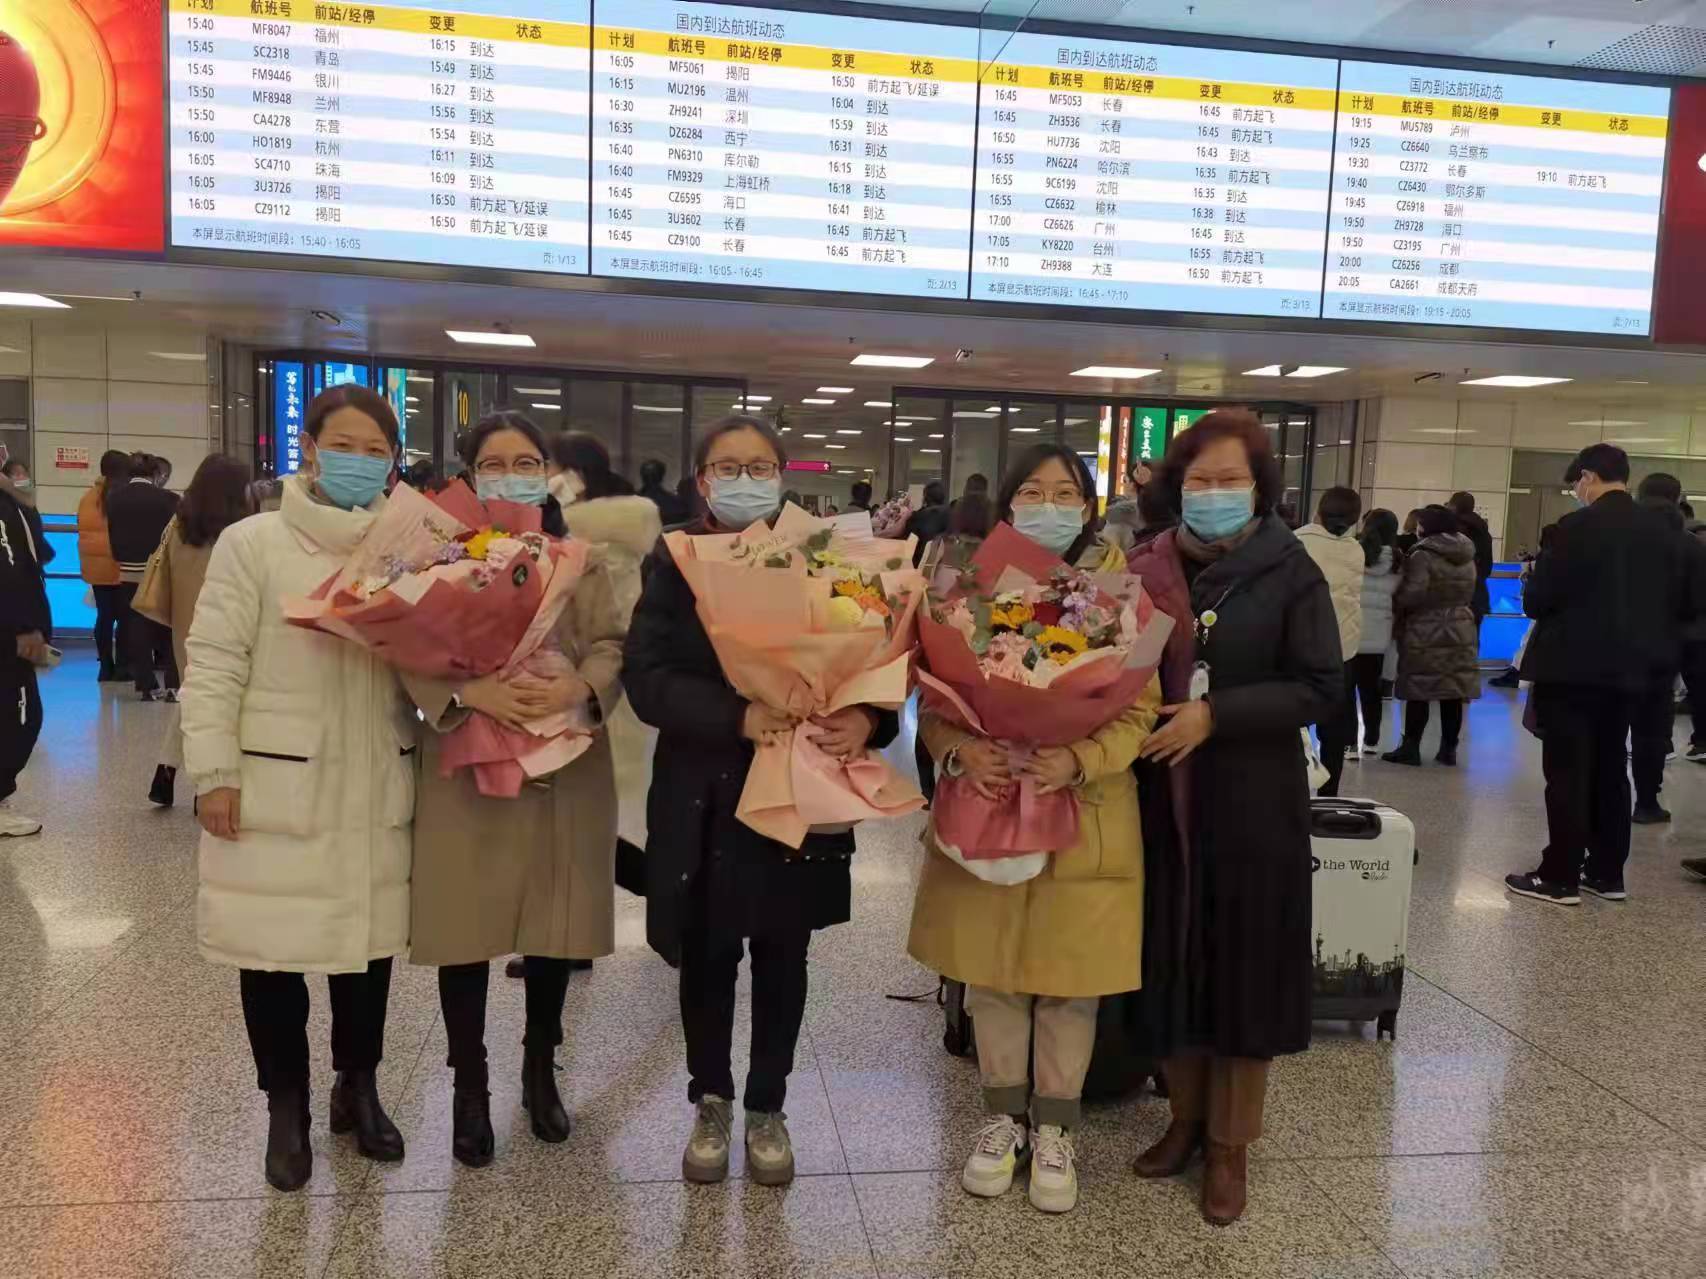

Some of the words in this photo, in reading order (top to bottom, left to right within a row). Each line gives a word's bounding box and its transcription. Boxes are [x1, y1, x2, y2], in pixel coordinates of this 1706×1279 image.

[249, 0, 292, 17] 航班号
[315, 4, 375, 24] 前站/经停
[428, 16, 456, 32] 变更
[516, 23, 542, 39] 状态
[677, 13, 785, 38] 国内到达航班动态
[187, 17, 214, 30] 15:40
[251, 23, 291, 37] MF8047
[315, 28, 339, 44] 福州
[431, 39, 455, 51] 16:15
[470, 42, 494, 57] 到达
[187, 40, 213, 53] 15:45
[253, 45, 289, 60] SC2318
[315, 49, 340, 67] 青岛
[430, 61, 456, 74] 15:49
[469, 64, 496, 80] 到达
[608, 32, 634, 48] 计划
[667, 37, 706, 55] 航班号
[727, 43, 782, 62] 前站/经停
[831, 53, 855, 69] 变更
[910, 60, 933, 76] 状态
[1058, 48, 1157, 71] 国内到达航班动态
[187, 63, 213, 76] 15:45
[251, 68, 291, 82] FM9446
[315, 73, 339, 88] 银川
[609, 56, 634, 68] 16:05
[668, 60, 704, 75] MF5061
[726, 66, 749, 80] 揭阳
[831, 76, 854, 88] 16:50
[868, 79, 939, 96] 前方起飞/延误
[995, 66, 1018, 83] 计划
[1047, 72, 1084, 88] 航班号
[1104, 76, 1154, 94] 前站/经停
[1199, 84, 1222, 99] 变更
[1273, 89, 1295, 104] 状态
[187, 85, 214, 99] 15:50
[252, 90, 292, 104] MF8948
[315, 96, 339, 112] 兰州
[608, 77, 633, 90] 16:15
[667, 82, 705, 96] MU2196
[725, 88, 748, 103] 温州
[1410, 78, 1503, 102] 国内到达航班动态
[609, 99, 633, 111] 16:30
[668, 104, 701, 119] ZH9241
[995, 90, 1016, 101] 16:45
[1049, 93, 1082, 107] MF5053
[1104, 98, 1122, 112] 长春
[1199, 105, 1220, 117] 16:45
[1233, 108, 1275, 123] 前方起飞
[1351, 95, 1374, 112] 计划
[1400, 99, 1436, 116] 航班号
[1451, 103, 1501, 121] 前站/经停
[1539, 112, 1562, 128] 变更
[1608, 116, 1630, 132] 状态
[187, 108, 214, 121] 15:50
[252, 113, 291, 127] CA4278
[316, 119, 340, 134] 东营
[608, 120, 632, 134] 16:35
[668, 125, 702, 140] DZ6284
[725, 131, 748, 147] 西宁
[993, 110, 1016, 123] 16:45
[1048, 115, 1080, 128] ZH3536
[1100, 120, 1121, 133] 长春
[1197, 126, 1219, 138] 16:45
[1351, 117, 1371, 128] 19:15
[1400, 121, 1432, 133] MU5789
[187, 131, 214, 144] 16:00
[252, 136, 291, 150] HO1819
[315, 140, 339, 157] 杭州
[992, 132, 1015, 143] 16:50
[1047, 136, 1079, 148] HU7736
[1348, 136, 1370, 149] 19:25
[1399, 140, 1430, 152] CZ6640
[187, 153, 214, 166] 16:05
[254, 158, 290, 171] SC4710
[316, 163, 340, 178] 珠海
[608, 144, 632, 156] 16:40
[668, 148, 702, 162] PN6310
[724, 153, 759, 168] 库尔勒
[991, 153, 1014, 164] 16:55
[1045, 156, 1078, 169] PN6224
[607, 164, 633, 177] 16:40
[667, 170, 704, 183] FM9329
[724, 174, 770, 192] 上海虹桥
[991, 174, 1013, 185] 16:55
[1045, 177, 1076, 190] 9C6199
[1346, 176, 1368, 189] 19:40
[1397, 180, 1427, 192] CZ6430
[1348, 157, 1368, 168] 19:30
[1399, 160, 1428, 172] CZ3772
[1448, 165, 1467, 177] 长春
[1536, 171, 1557, 182] 19:10
[1568, 174, 1606, 188] 前方起飞
[188, 176, 215, 188] 16:05
[253, 180, 291, 194] 3U3726
[316, 184, 340, 200] 揭阳
[430, 193, 455, 206] 16:50
[470, 196, 548, 216] 前方起飞/延误
[608, 186, 632, 198] 16:45
[668, 192, 701, 204] CZ6595
[989, 194, 1012, 206] 16:55
[1044, 198, 1075, 211] CZ6632
[1344, 197, 1365, 208] 19:45
[1396, 200, 1424, 212] CZ6918
[1444, 204, 1463, 216] 福州
[188, 198, 215, 210] 16:05
[254, 203, 290, 216] CZ9112
[316, 207, 340, 222] 揭阳
[430, 216, 455, 228] 16:50
[471, 218, 547, 237] 前方起飞/延误
[607, 208, 632, 221] 16:45
[666, 212, 701, 226] 3U3602
[723, 216, 745, 232] 长春
[863, 227, 907, 244] 前方起飞
[988, 215, 1011, 226] 17:00
[1043, 218, 1073, 231] CZ6626
[1343, 216, 1364, 228] 19:50
[1393, 219, 1424, 232] ZH9728
[608, 230, 632, 241] 16:45
[667, 234, 700, 246] CZ9100
[723, 239, 744, 252] 长春
[862, 248, 906, 263] 前方起飞
[986, 235, 1009, 247] 17:05
[1040, 239, 1074, 251] KY8220
[1342, 236, 1363, 247] 19:50
[1392, 240, 1422, 251] CZ3195
[1441, 243, 1460, 256] 广州
[986, 256, 1008, 267] 17:10
[1040, 259, 1072, 271] ZH9388
[1339, 256, 1361, 268] 20:00
[1391, 259, 1420, 271] CZ6256
[1439, 262, 1460, 275] 成都
[1337, 276, 1360, 287] 20:05
[1389, 279, 1418, 290] CA2661
[458, 389, 469, 426] 10
[1323, 859, 1346, 870] the
[1349, 859, 1390, 871] World
